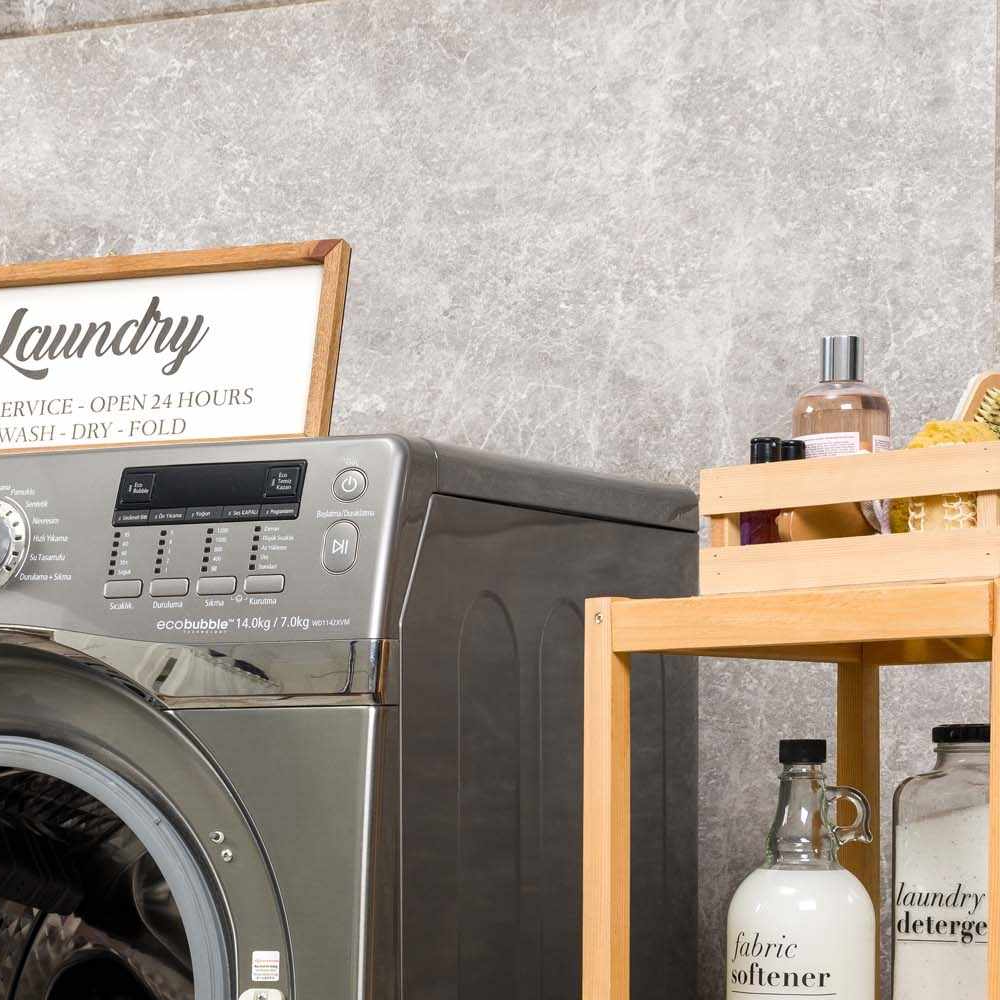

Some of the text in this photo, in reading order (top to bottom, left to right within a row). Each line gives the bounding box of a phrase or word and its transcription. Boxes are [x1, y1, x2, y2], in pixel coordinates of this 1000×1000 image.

[90, 393, 148, 413] OPEN
[150, 391, 173, 411] 24
[177, 387, 254, 408] HOURS
[71, 420, 112, 441] DRY
[128, 417, 187, 438] FOLD
[236, 617, 271, 632] 14.0kg
[280, 616, 310, 630] 7.0kg
[896, 881, 986, 915] laundry
[731, 930, 798, 962] fabric
[730, 961, 831, 988] softener
